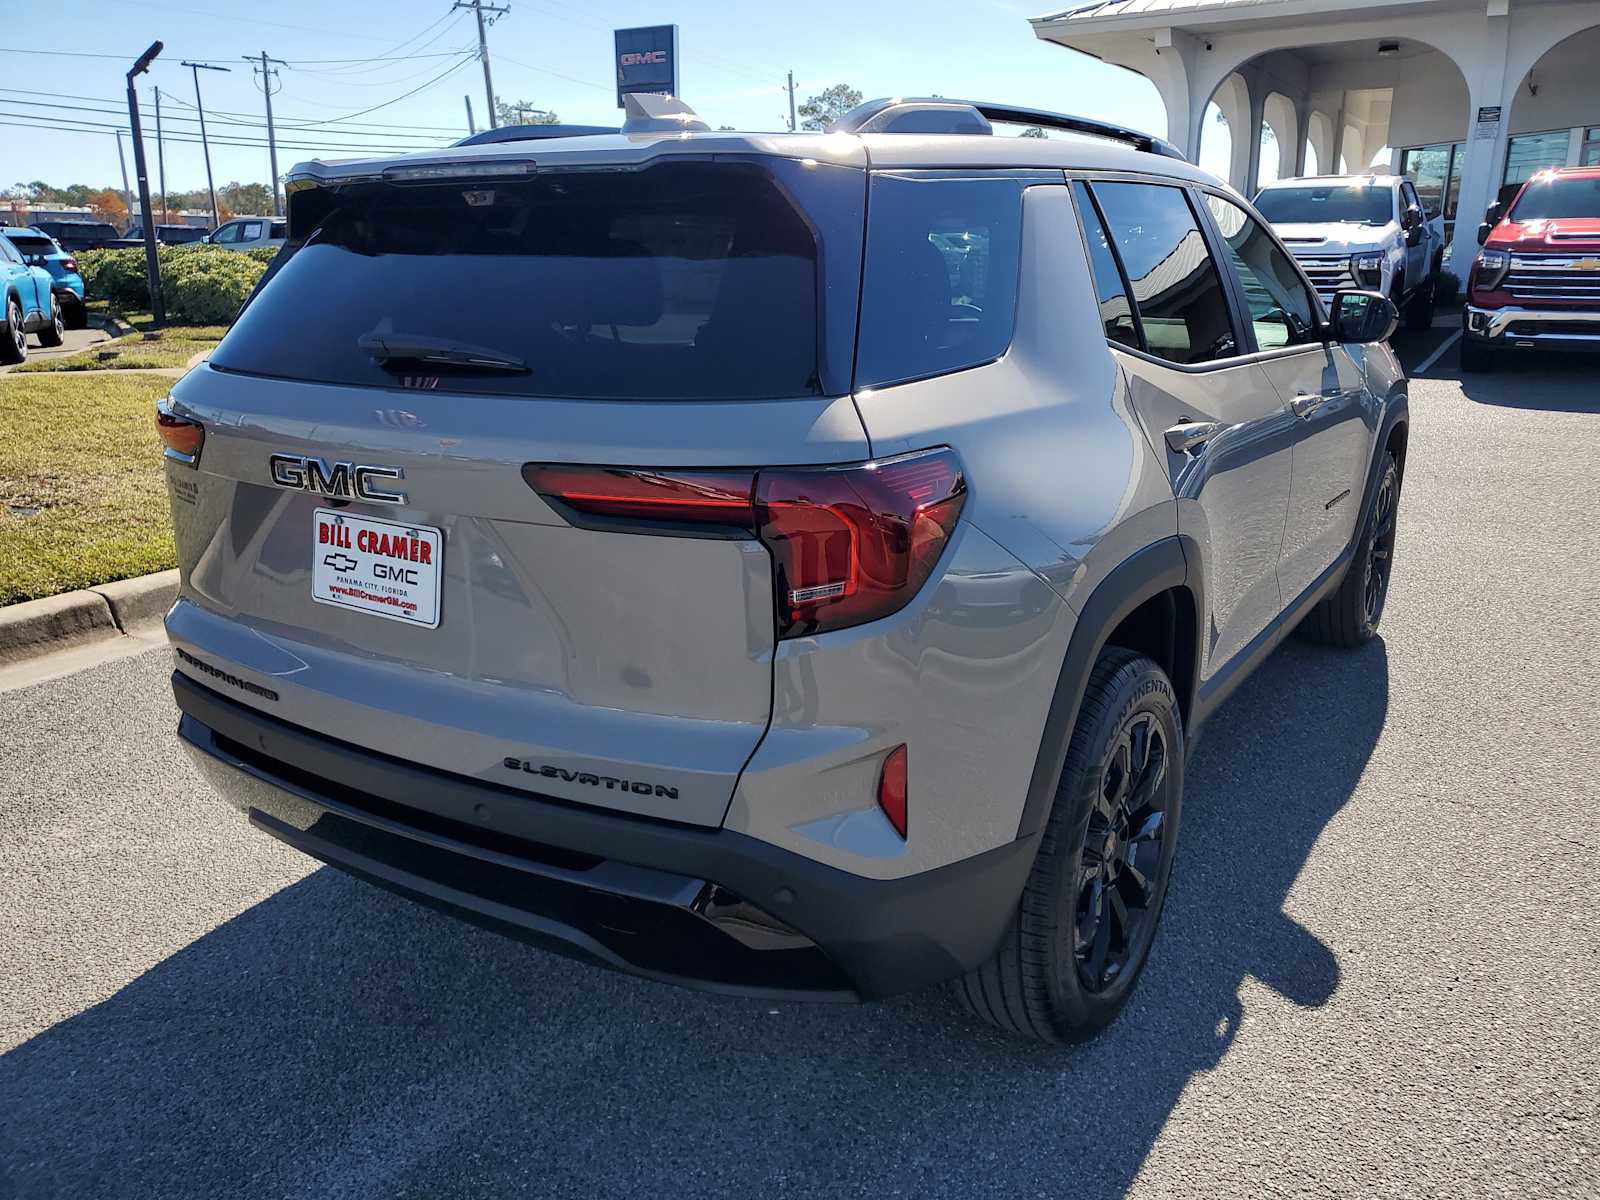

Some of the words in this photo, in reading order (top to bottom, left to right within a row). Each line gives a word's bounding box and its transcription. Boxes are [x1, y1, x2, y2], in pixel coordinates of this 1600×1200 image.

[621, 51, 666, 65] GMC
[269, 452, 408, 504] GMC
[319, 522, 352, 549] BILL
[357, 529, 432, 565] CRAMER
[336, 576, 362, 587] PANAMA
[381, 585, 408, 597] FLORIDA
[373, 563, 418, 586] GMC
[504, 757, 679, 799] ELEVATION
